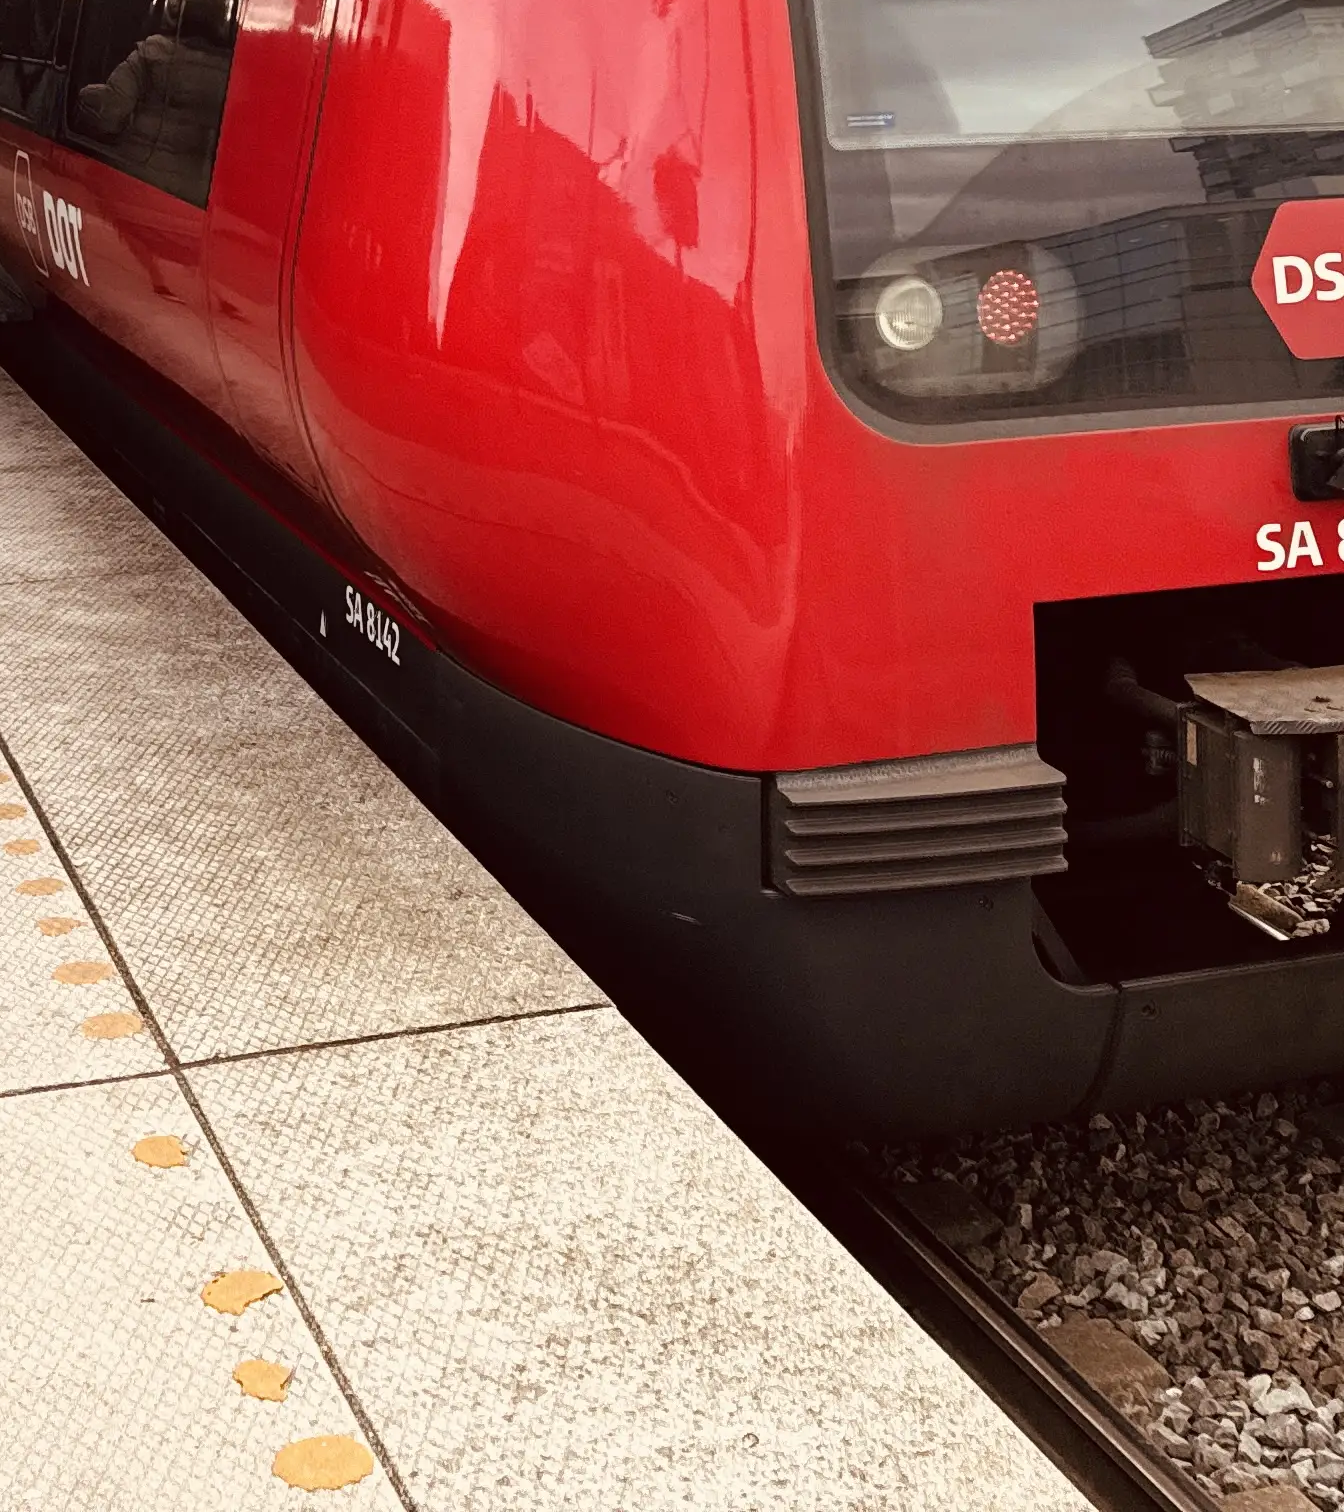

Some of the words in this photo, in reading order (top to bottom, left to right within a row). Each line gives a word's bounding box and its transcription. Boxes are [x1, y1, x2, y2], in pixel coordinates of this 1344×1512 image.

[16, 192, 37, 235] DSB
[1256, 520, 1323, 572] SA
[345, 585, 364, 634] SA
[366, 602, 401, 667] 8142
